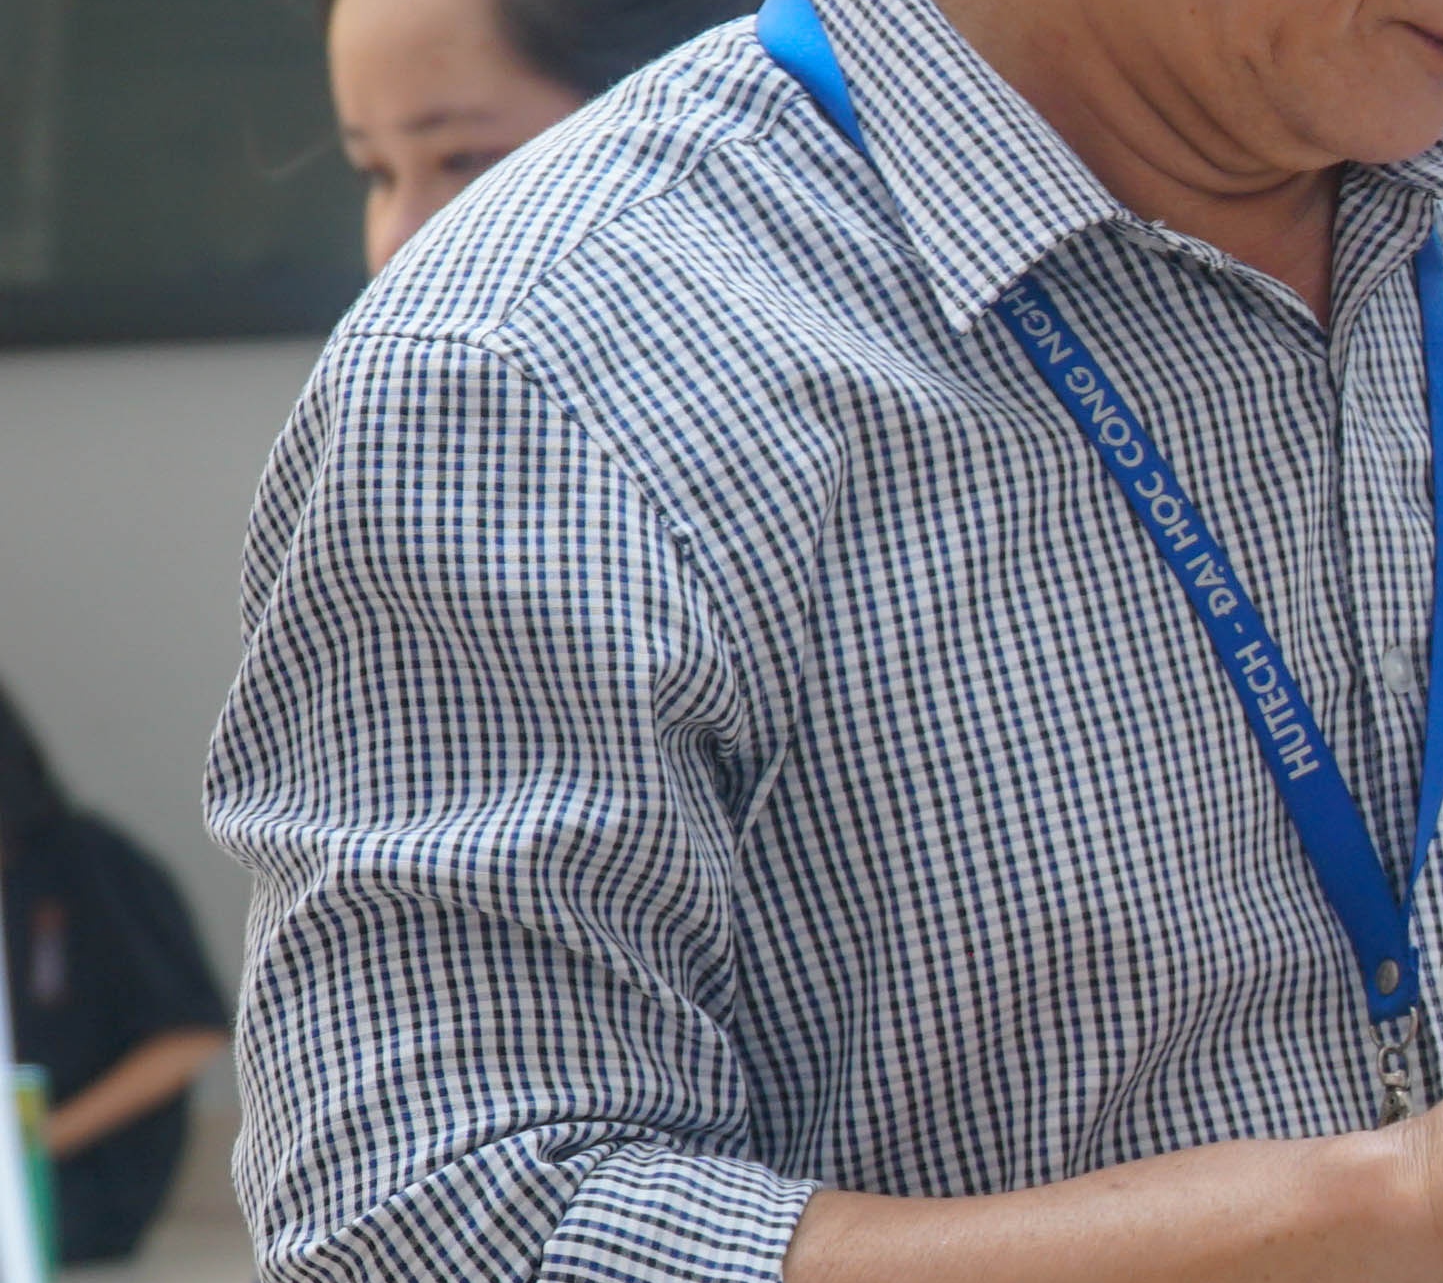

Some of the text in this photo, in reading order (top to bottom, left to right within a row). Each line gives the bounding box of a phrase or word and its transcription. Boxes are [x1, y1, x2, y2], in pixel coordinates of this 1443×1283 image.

[1001, 284, 1073, 366] NGH
[1064, 366, 1145, 468] CÔNG
[1133, 470, 1200, 553] HỌC
[1186, 557, 1238, 618] ĐẠI
[1235, 639, 1320, 780] HUTECH
